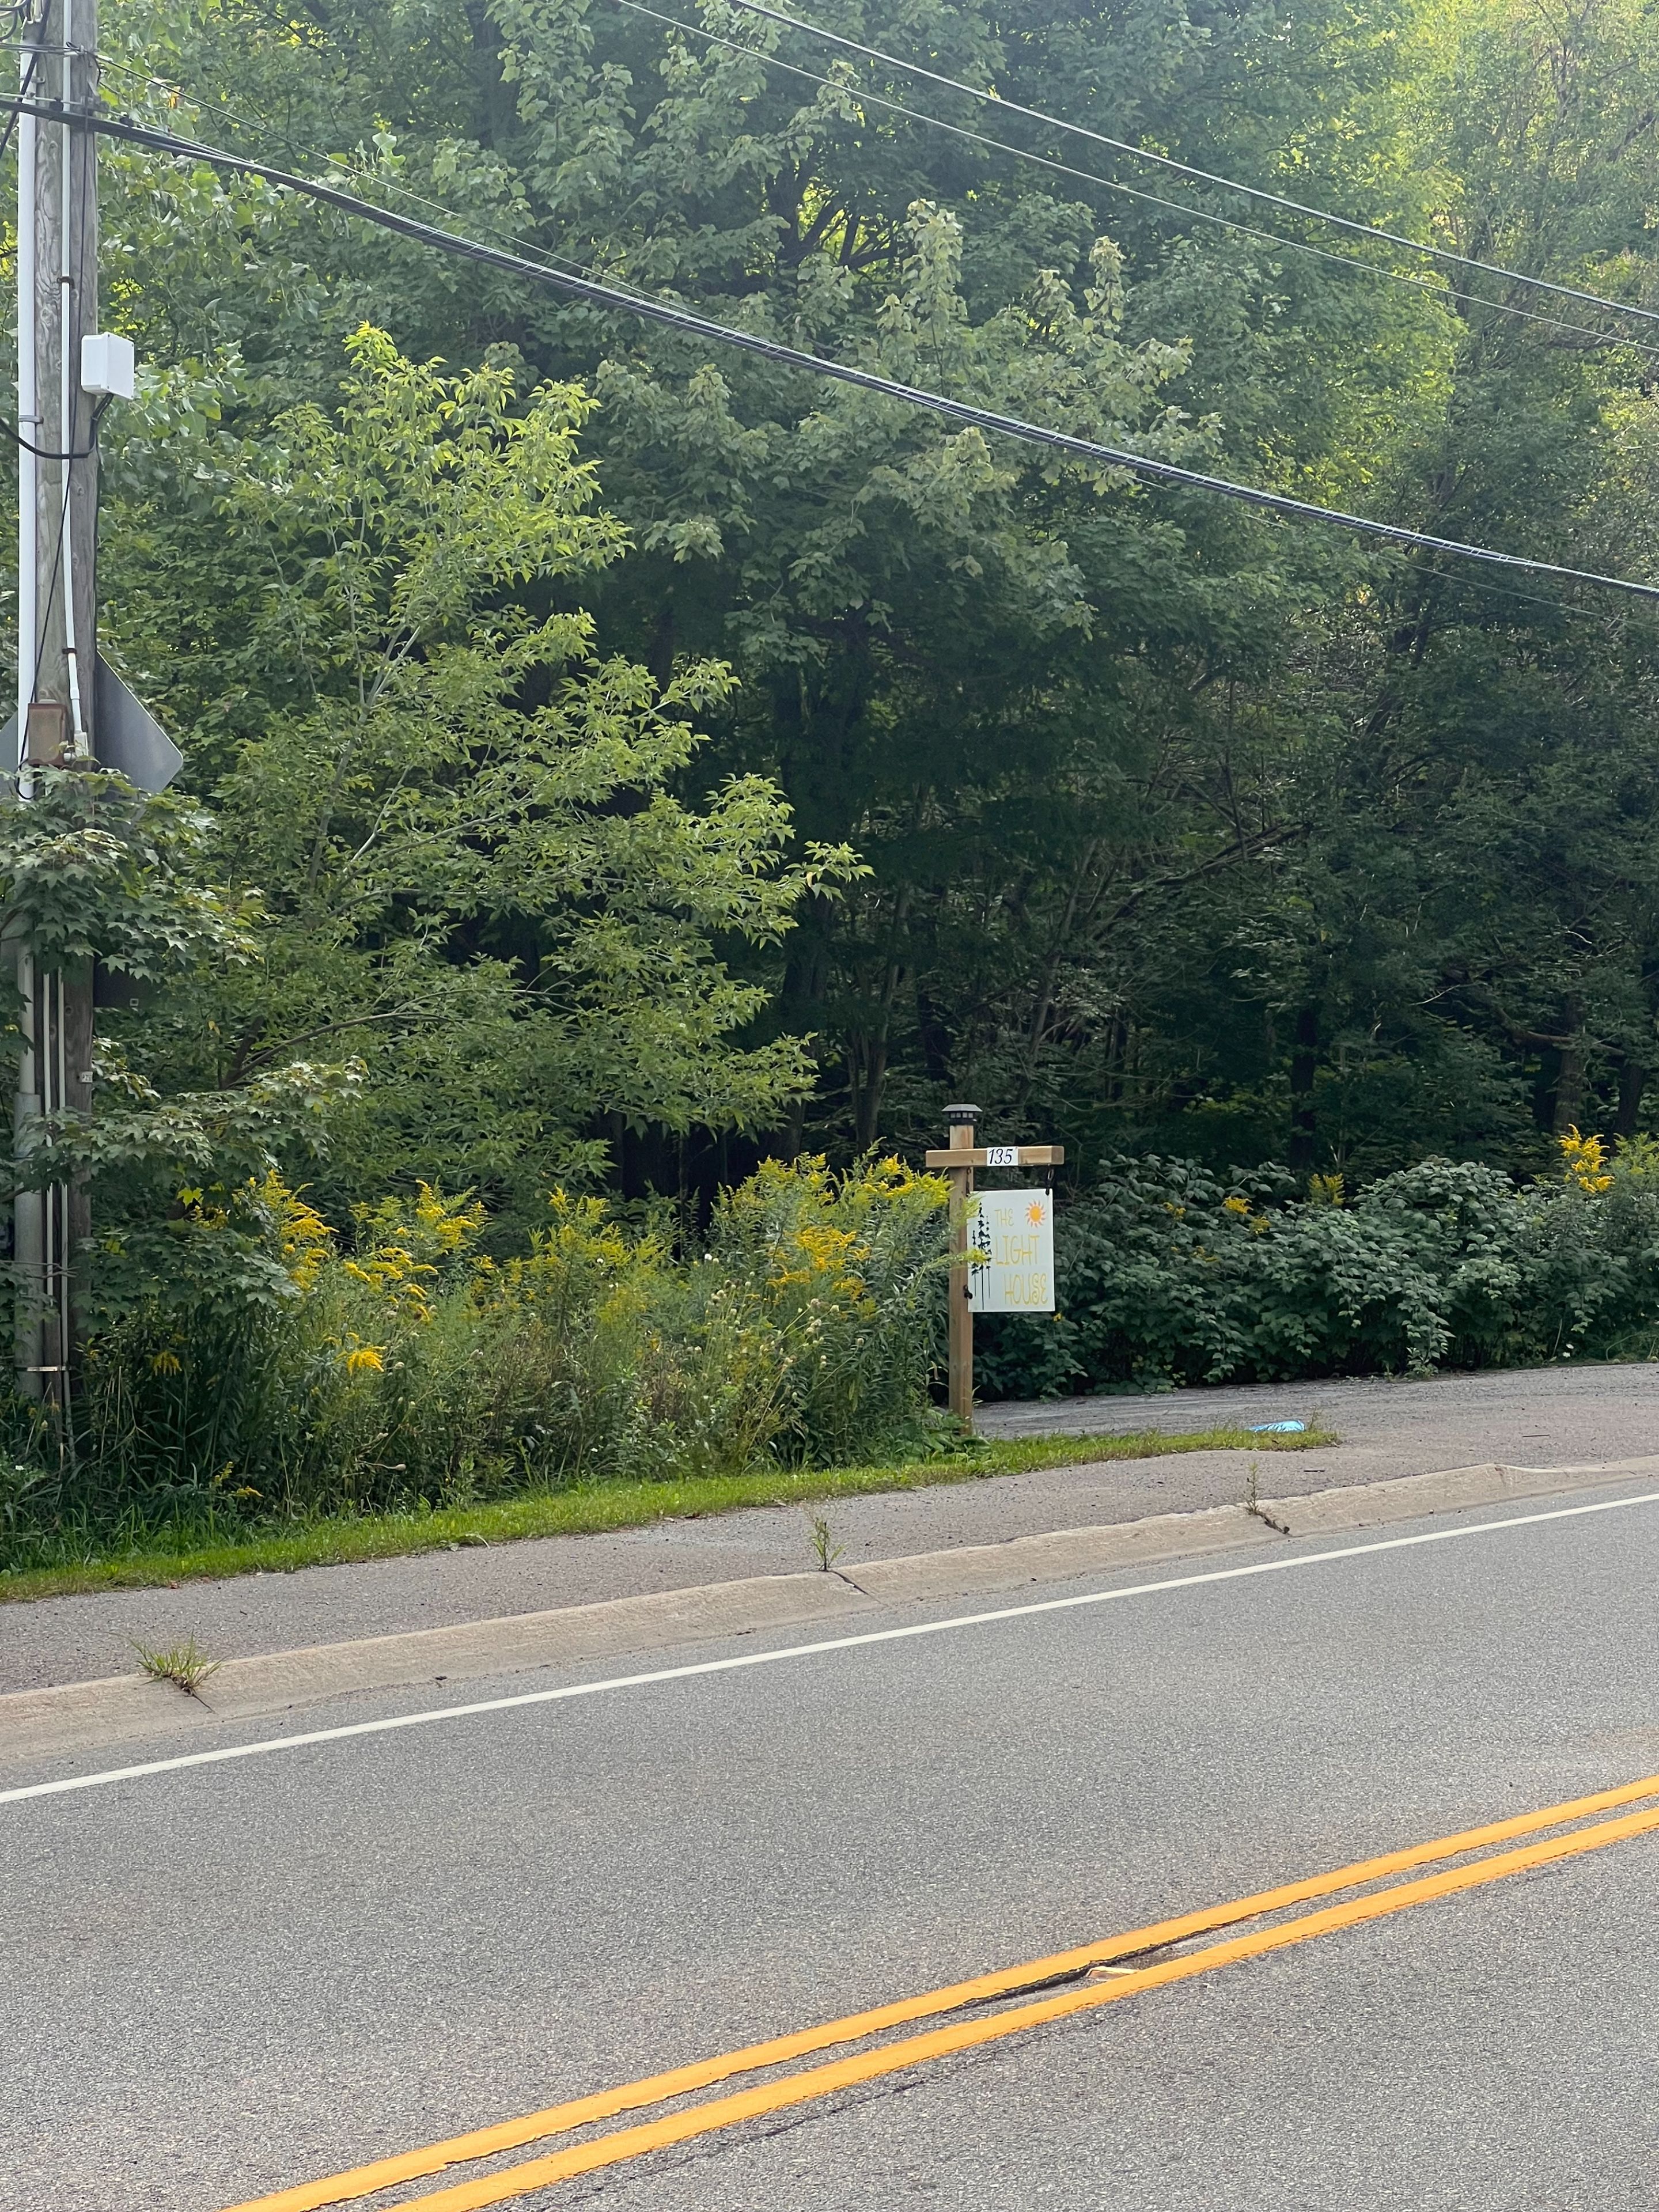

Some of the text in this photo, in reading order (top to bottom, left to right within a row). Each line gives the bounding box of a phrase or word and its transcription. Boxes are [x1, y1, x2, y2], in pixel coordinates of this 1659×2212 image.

[988, 1148, 1013, 1164] 135
[994, 1208, 1014, 1226] THE
[995, 1234, 1040, 1266] LIGHT
[1003, 1272, 1048, 1306] HOUSE
